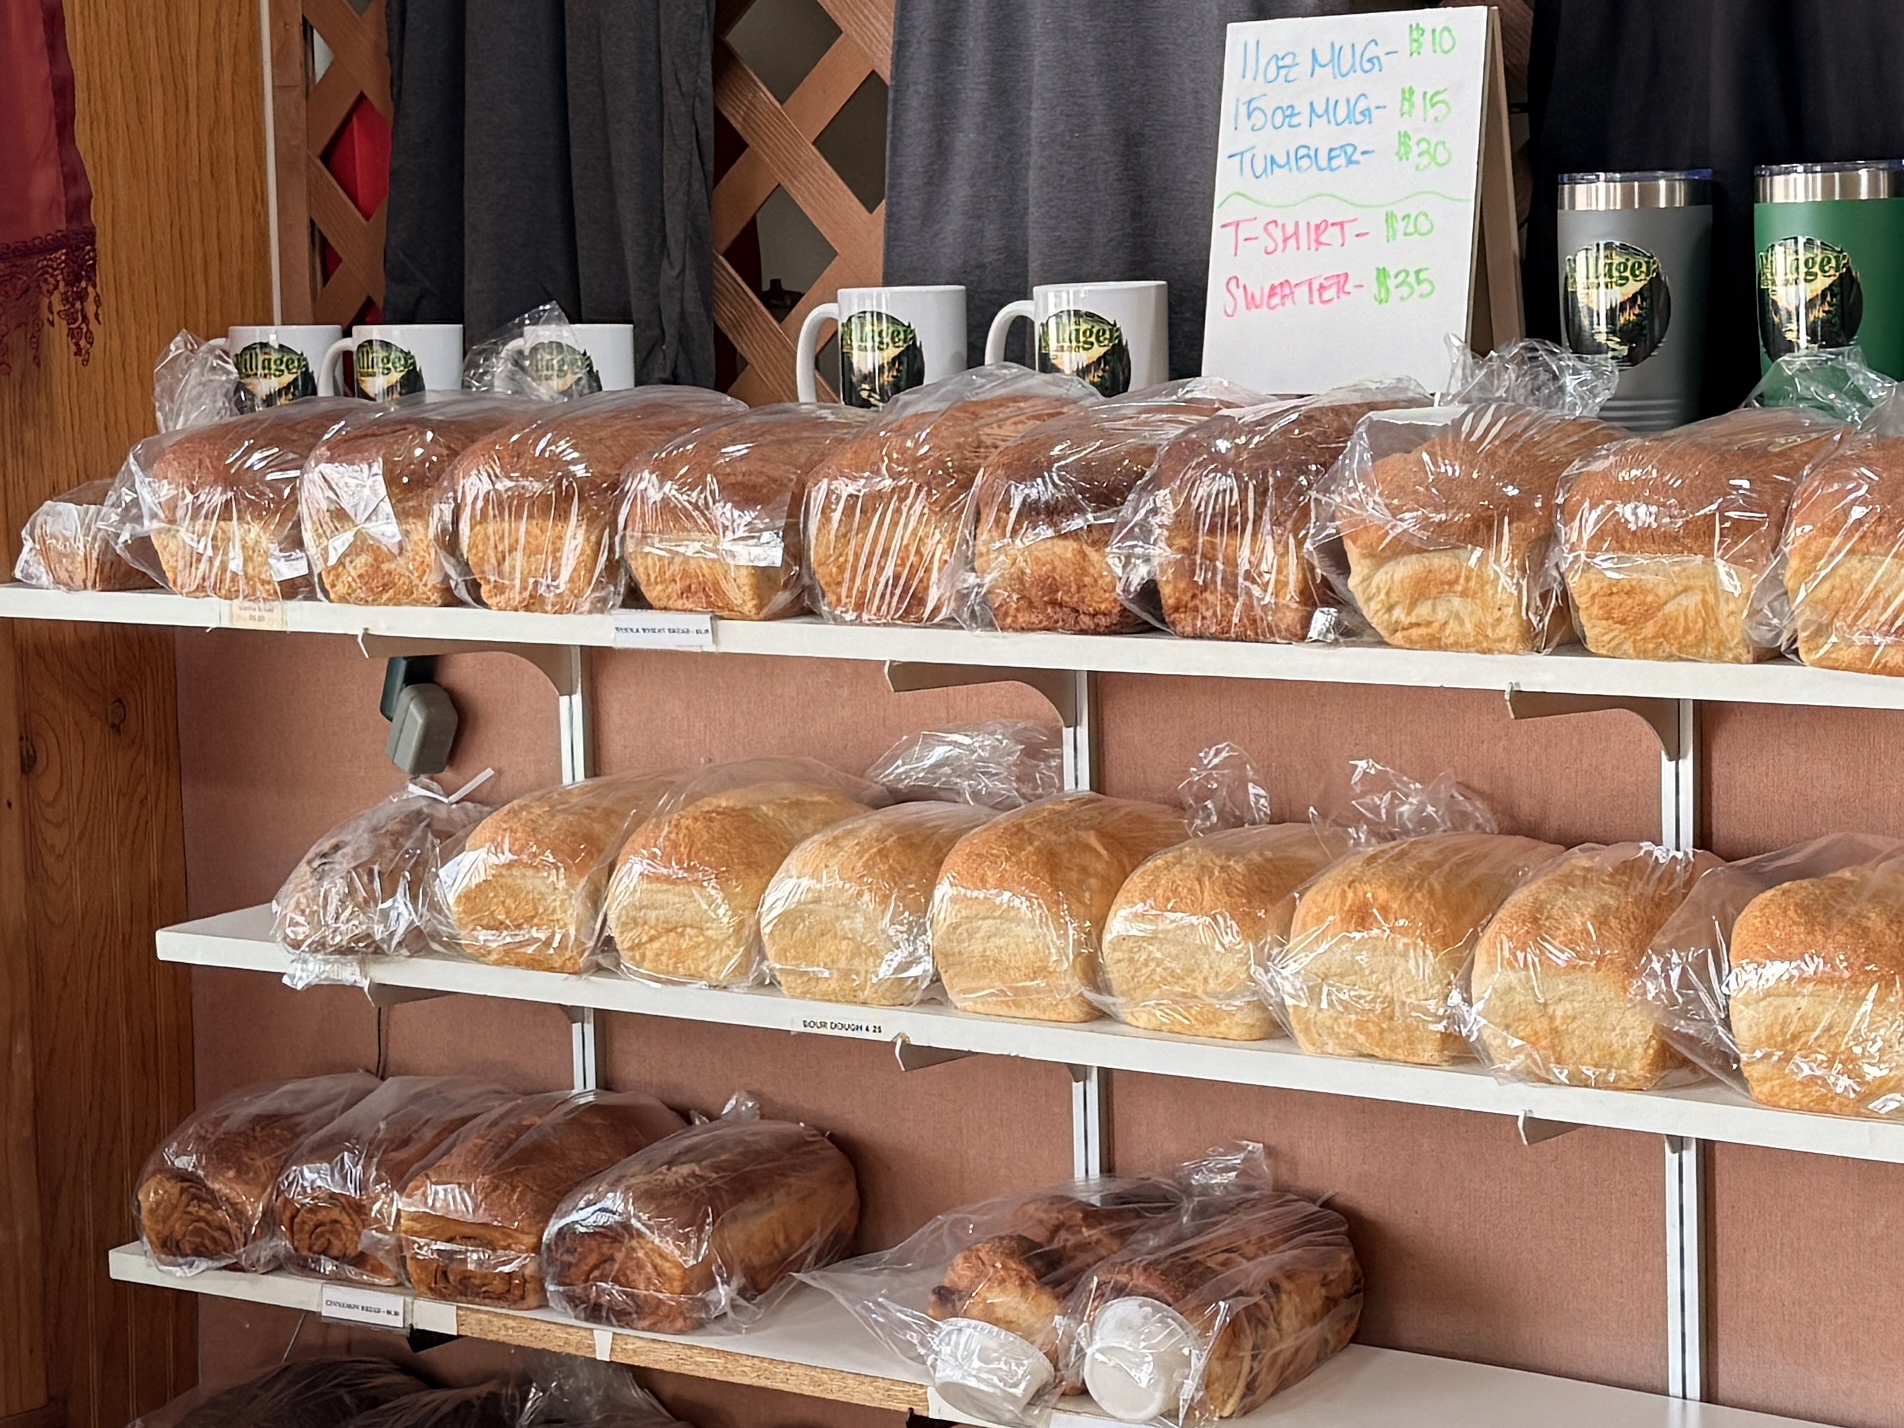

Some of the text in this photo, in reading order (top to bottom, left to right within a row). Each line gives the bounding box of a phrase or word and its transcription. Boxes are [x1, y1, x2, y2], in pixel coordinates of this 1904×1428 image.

[1408, 23, 1457, 57] $10
[1399, 86, 1453, 124] $15
[1395, 130, 1453, 172] $30
[1385, 210, 1435, 244] $20
[1374, 267, 1437, 306] $35
